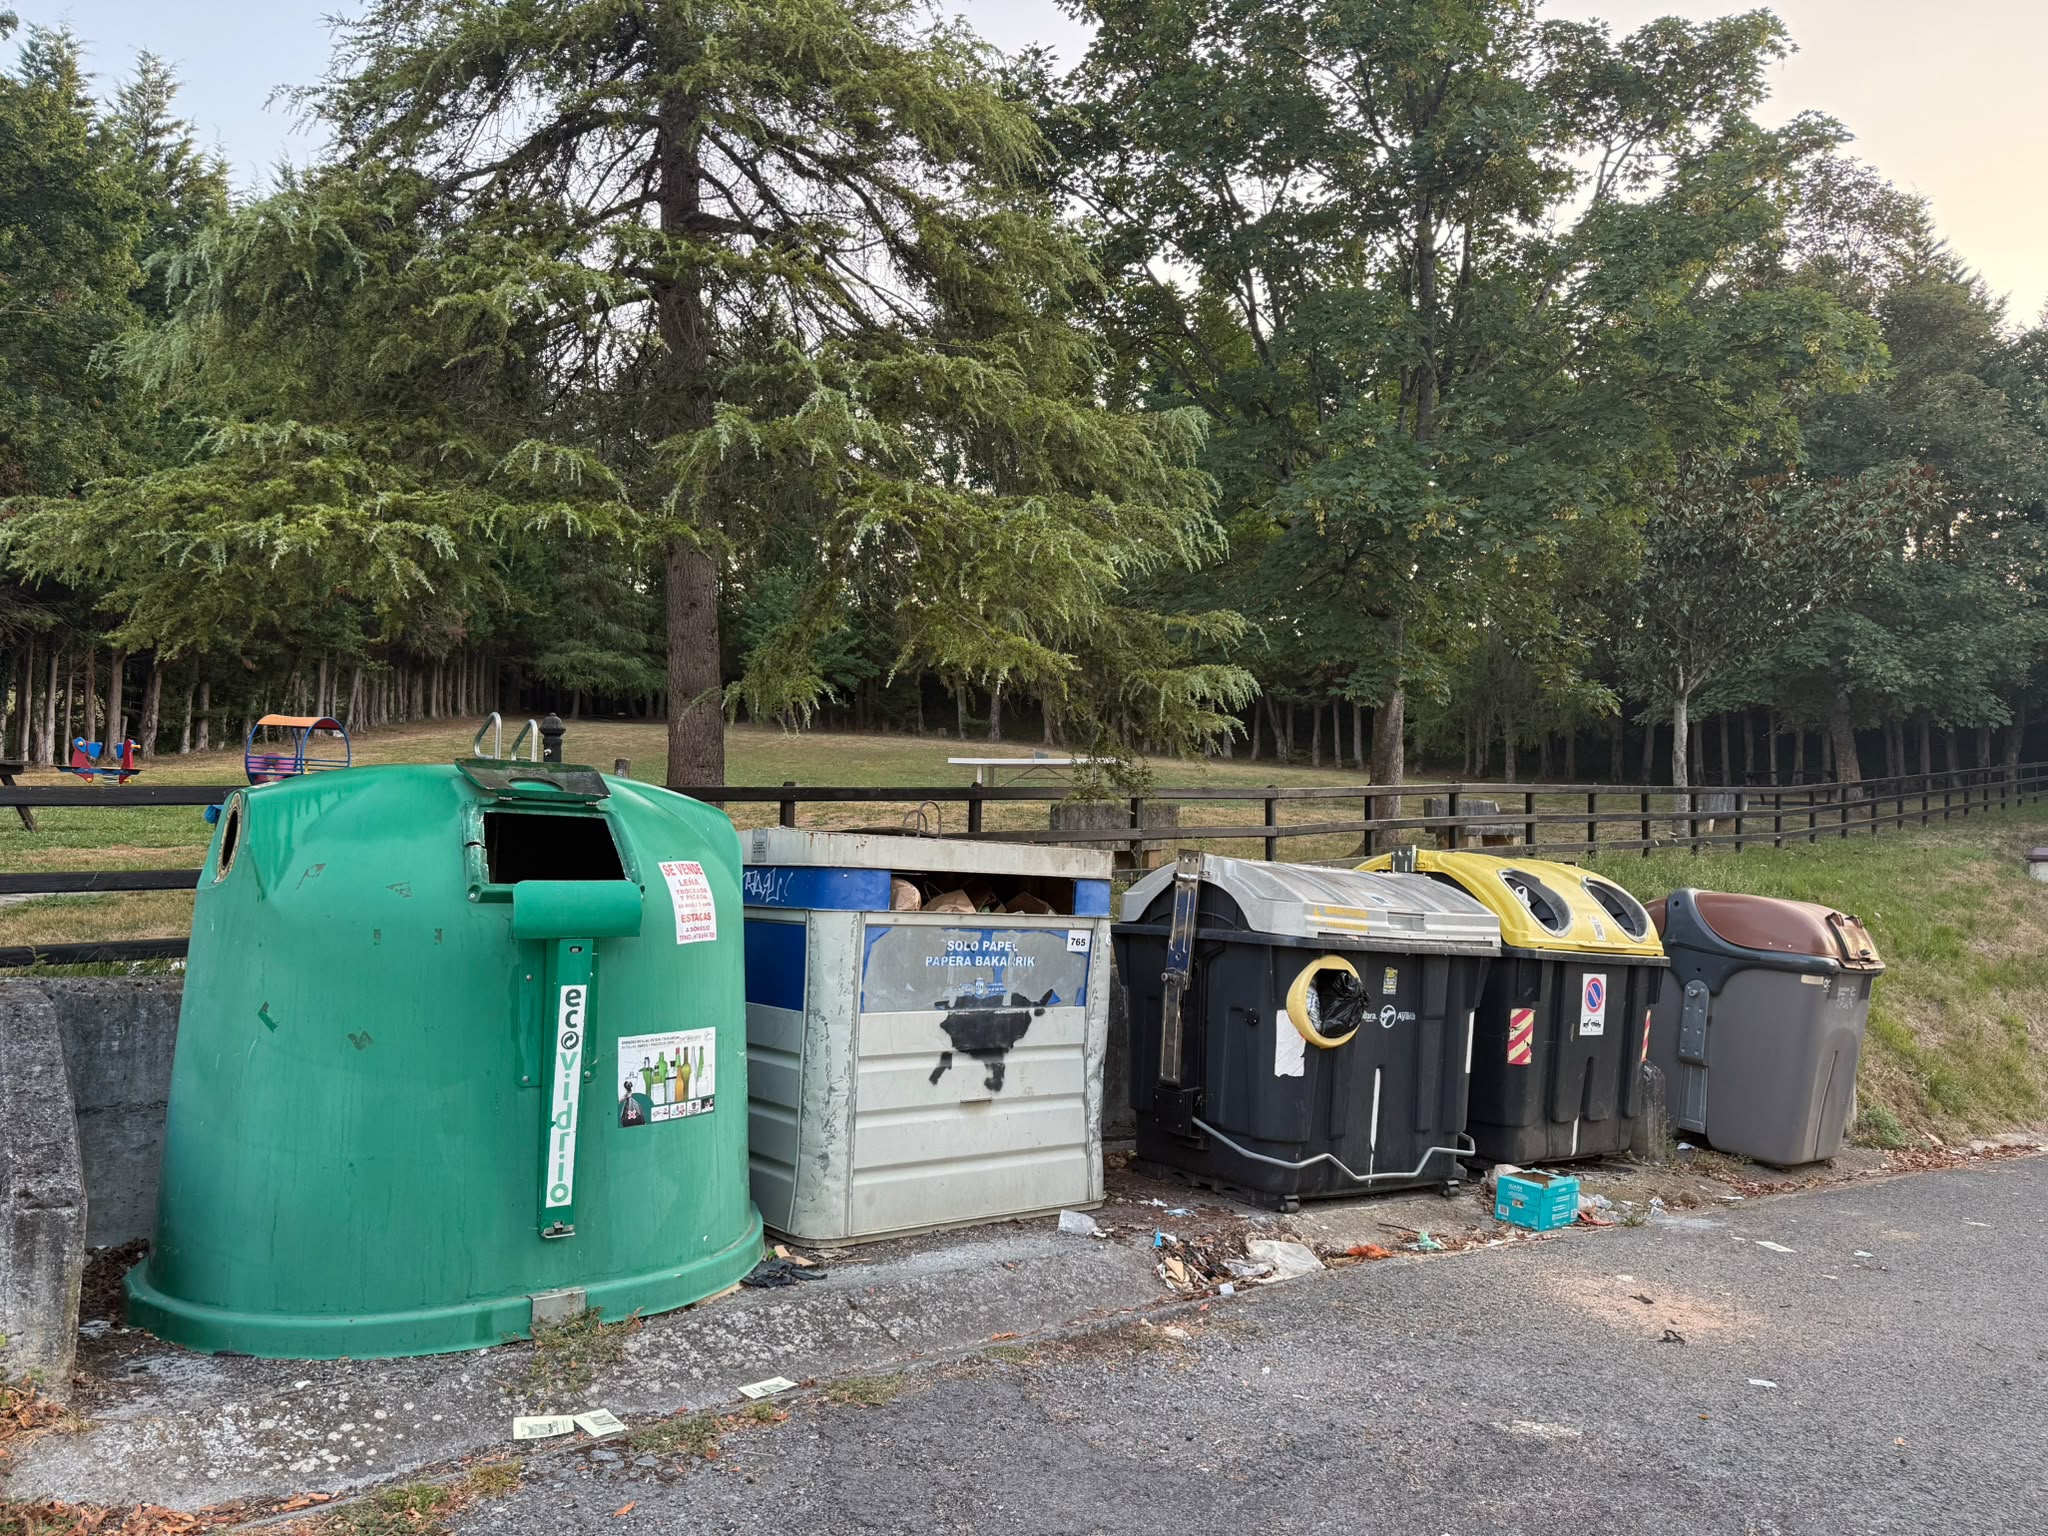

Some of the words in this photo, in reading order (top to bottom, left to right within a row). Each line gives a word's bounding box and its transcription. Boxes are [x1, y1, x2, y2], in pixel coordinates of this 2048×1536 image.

[662, 864, 677, 877] SE
[674, 863, 703, 876] VENDE
[681, 912, 711, 923] ESTACAS
[947, 940, 979, 952] SOLO
[1071, 937, 1086, 947] 765
[925, 956, 972, 967] PAPERA
[550, 988, 581, 1203] ecovidrio
